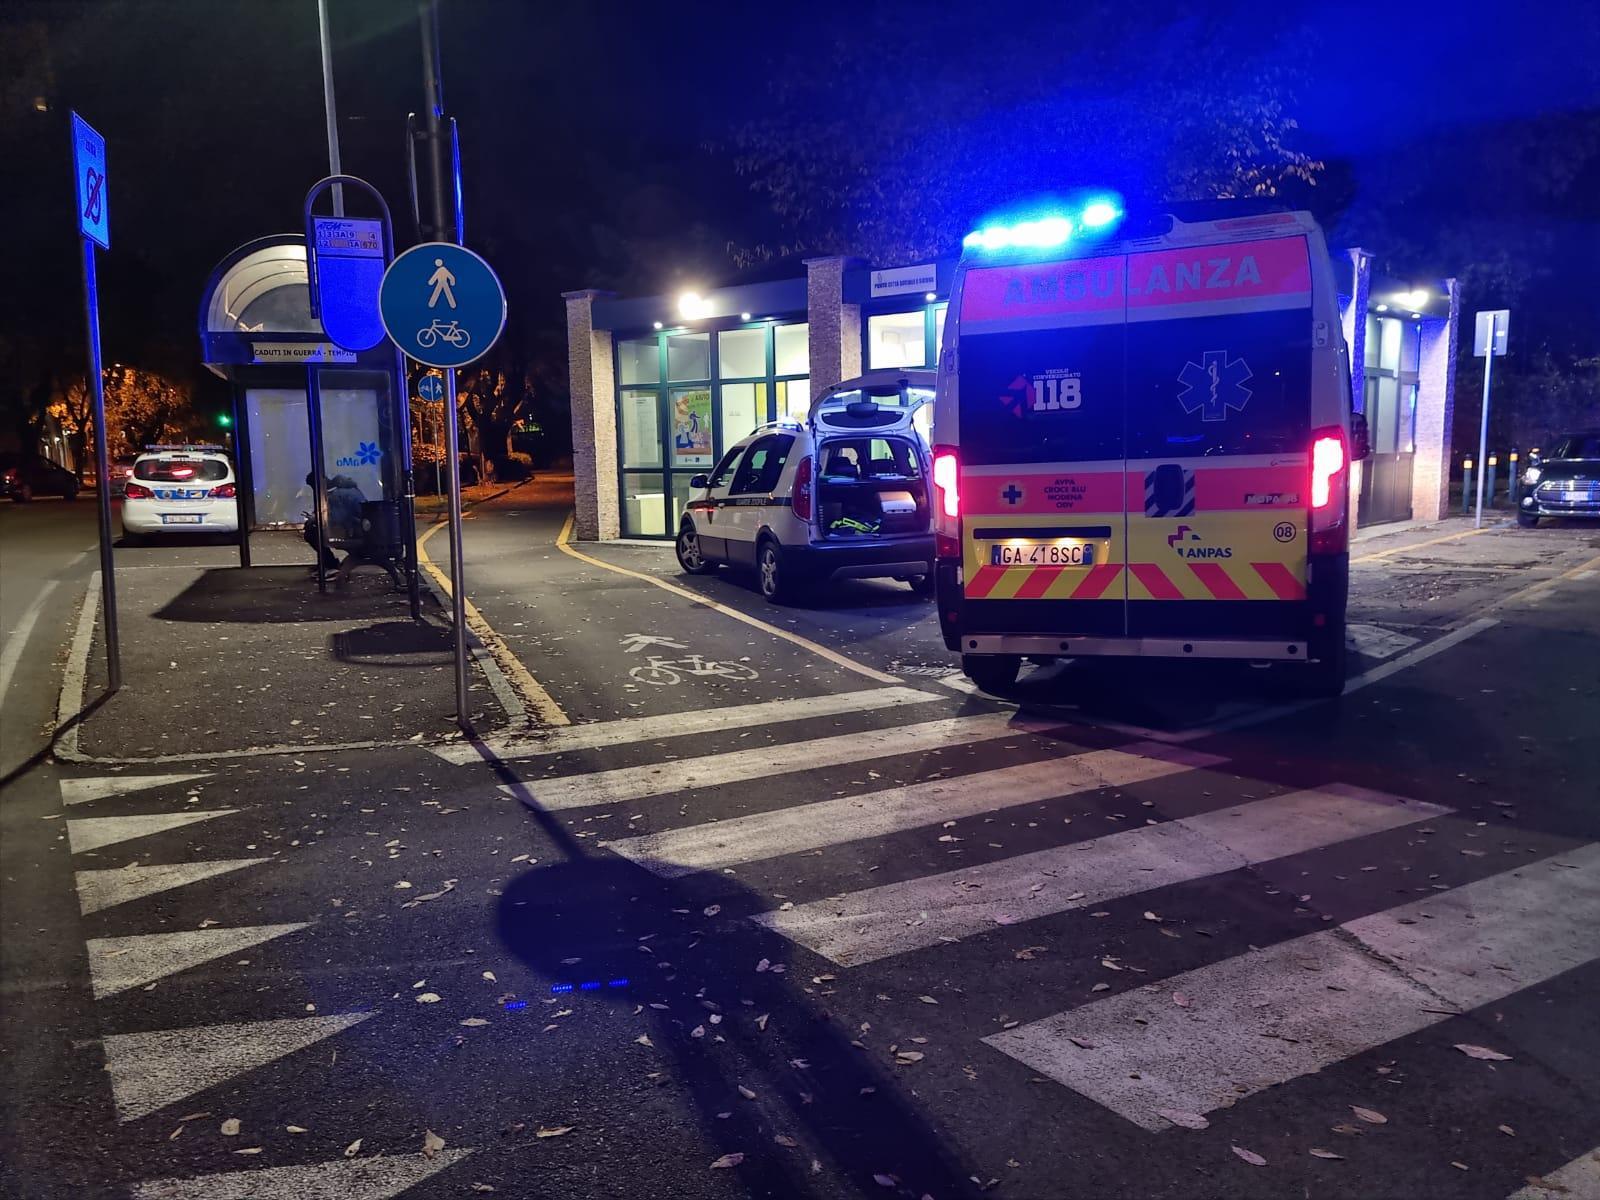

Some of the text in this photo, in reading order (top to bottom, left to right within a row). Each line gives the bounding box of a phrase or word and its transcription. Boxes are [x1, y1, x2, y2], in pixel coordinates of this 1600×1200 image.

[1003, 255, 1263, 305] AMBULANZA
[1033, 378, 1081, 411] 118
[1276, 526, 1292, 538] 08
[1003, 546, 1081, 563] GA 418SC
[1186, 547, 1232, 558] ANPAS
